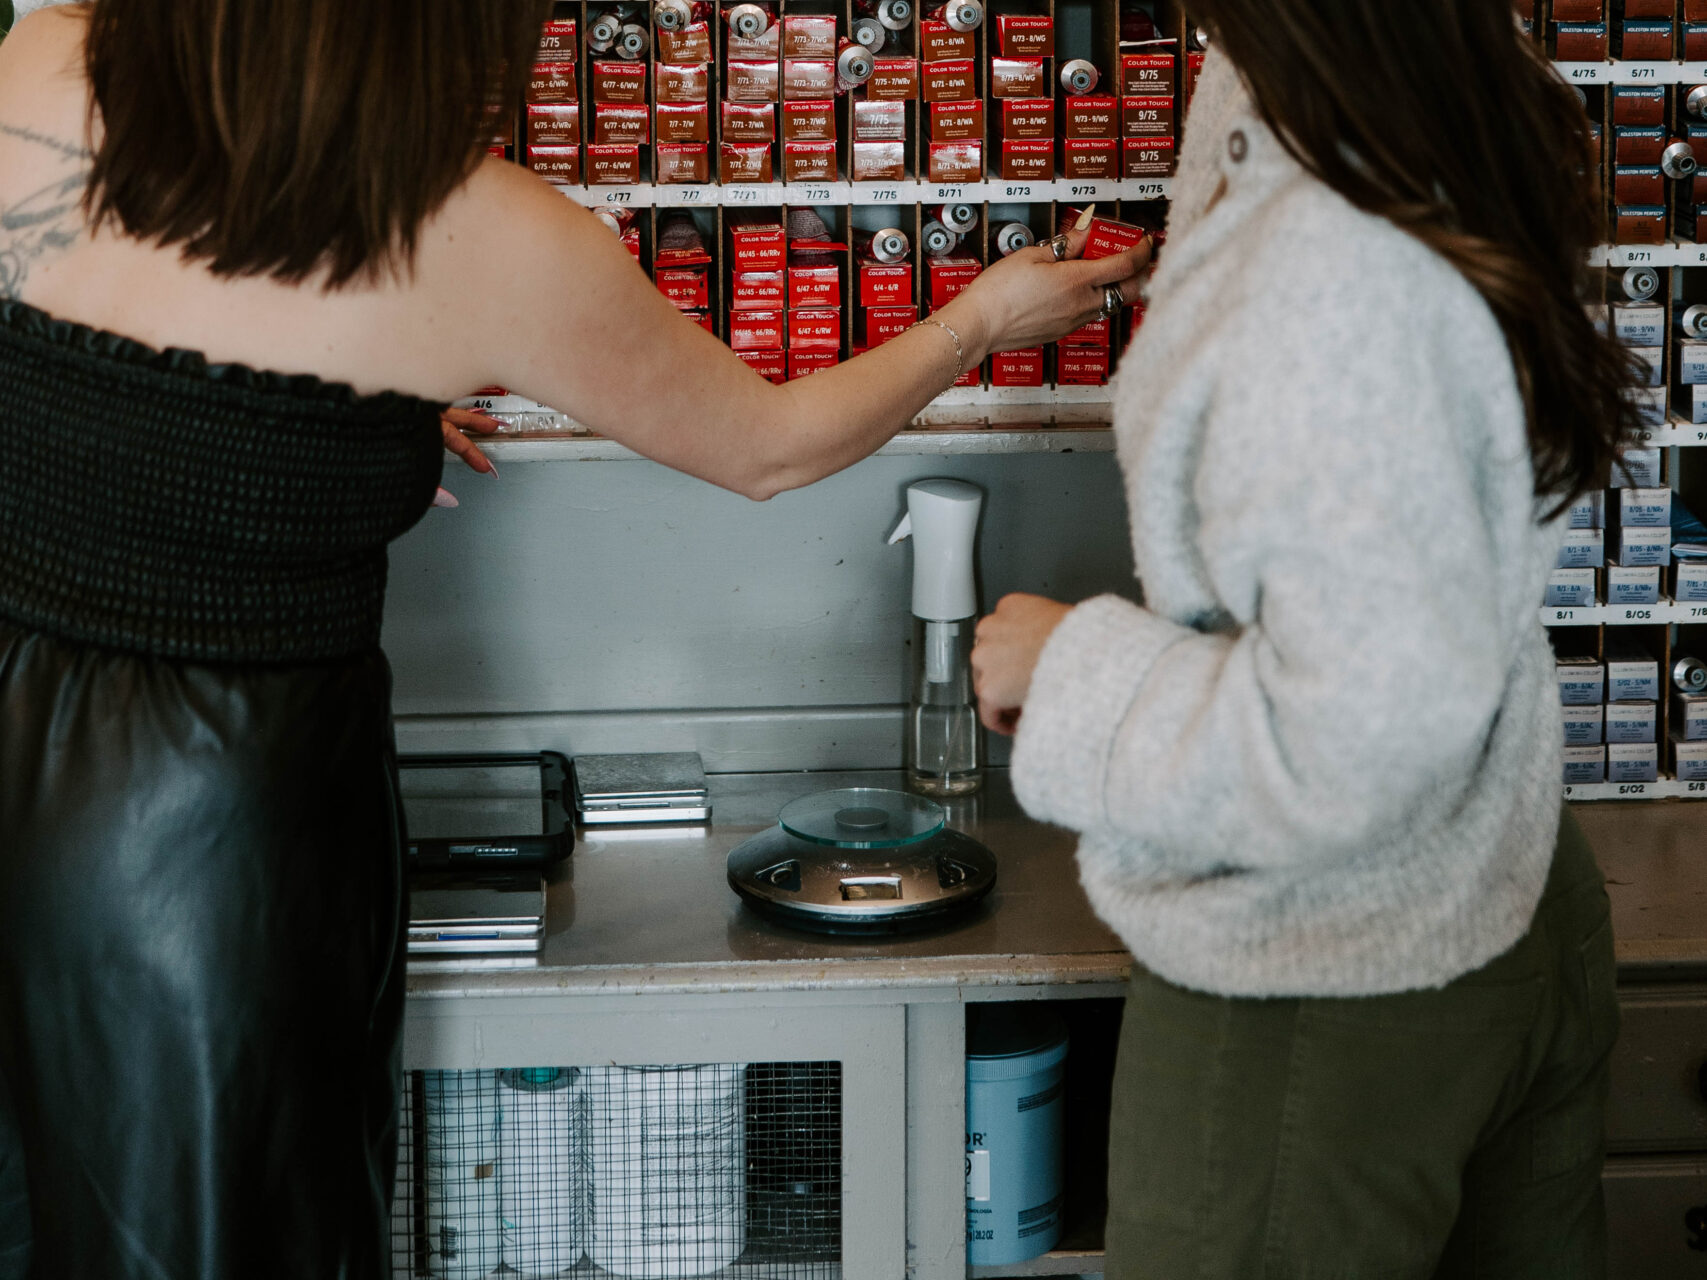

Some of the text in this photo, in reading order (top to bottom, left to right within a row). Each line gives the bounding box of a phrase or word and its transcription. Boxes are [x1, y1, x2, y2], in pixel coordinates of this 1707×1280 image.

[540, 37, 560, 48] 6/75
[1139, 69, 1158, 80] 9/75
[1572, 69, 1596, 78] 4/75
[1631, 69, 1655, 78] 5/71
[870, 114, 889, 125] 7/75
[1138, 110, 1157, 121] 9/75
[1140, 150, 1159, 161] 9/75
[938, 188, 962, 198] 8/71
[1006, 186, 1031, 196] 8/73
[1071, 186, 1096, 195] 9/73
[1139, 184, 1163, 194] 9/75
[606, 192, 631, 202] 6/77
[682, 191, 700, 200] 7/7
[806, 190, 830, 199] 7/73
[872, 190, 897, 200] 7/75
[1628, 252, 1651, 261] 8/71
[474, 400, 492, 409] 4/6
[1556, 611, 1573, 619] 8/1
[1625, 610, 1651, 619] 8/05
[1619, 785, 1645, 794] 5/02
